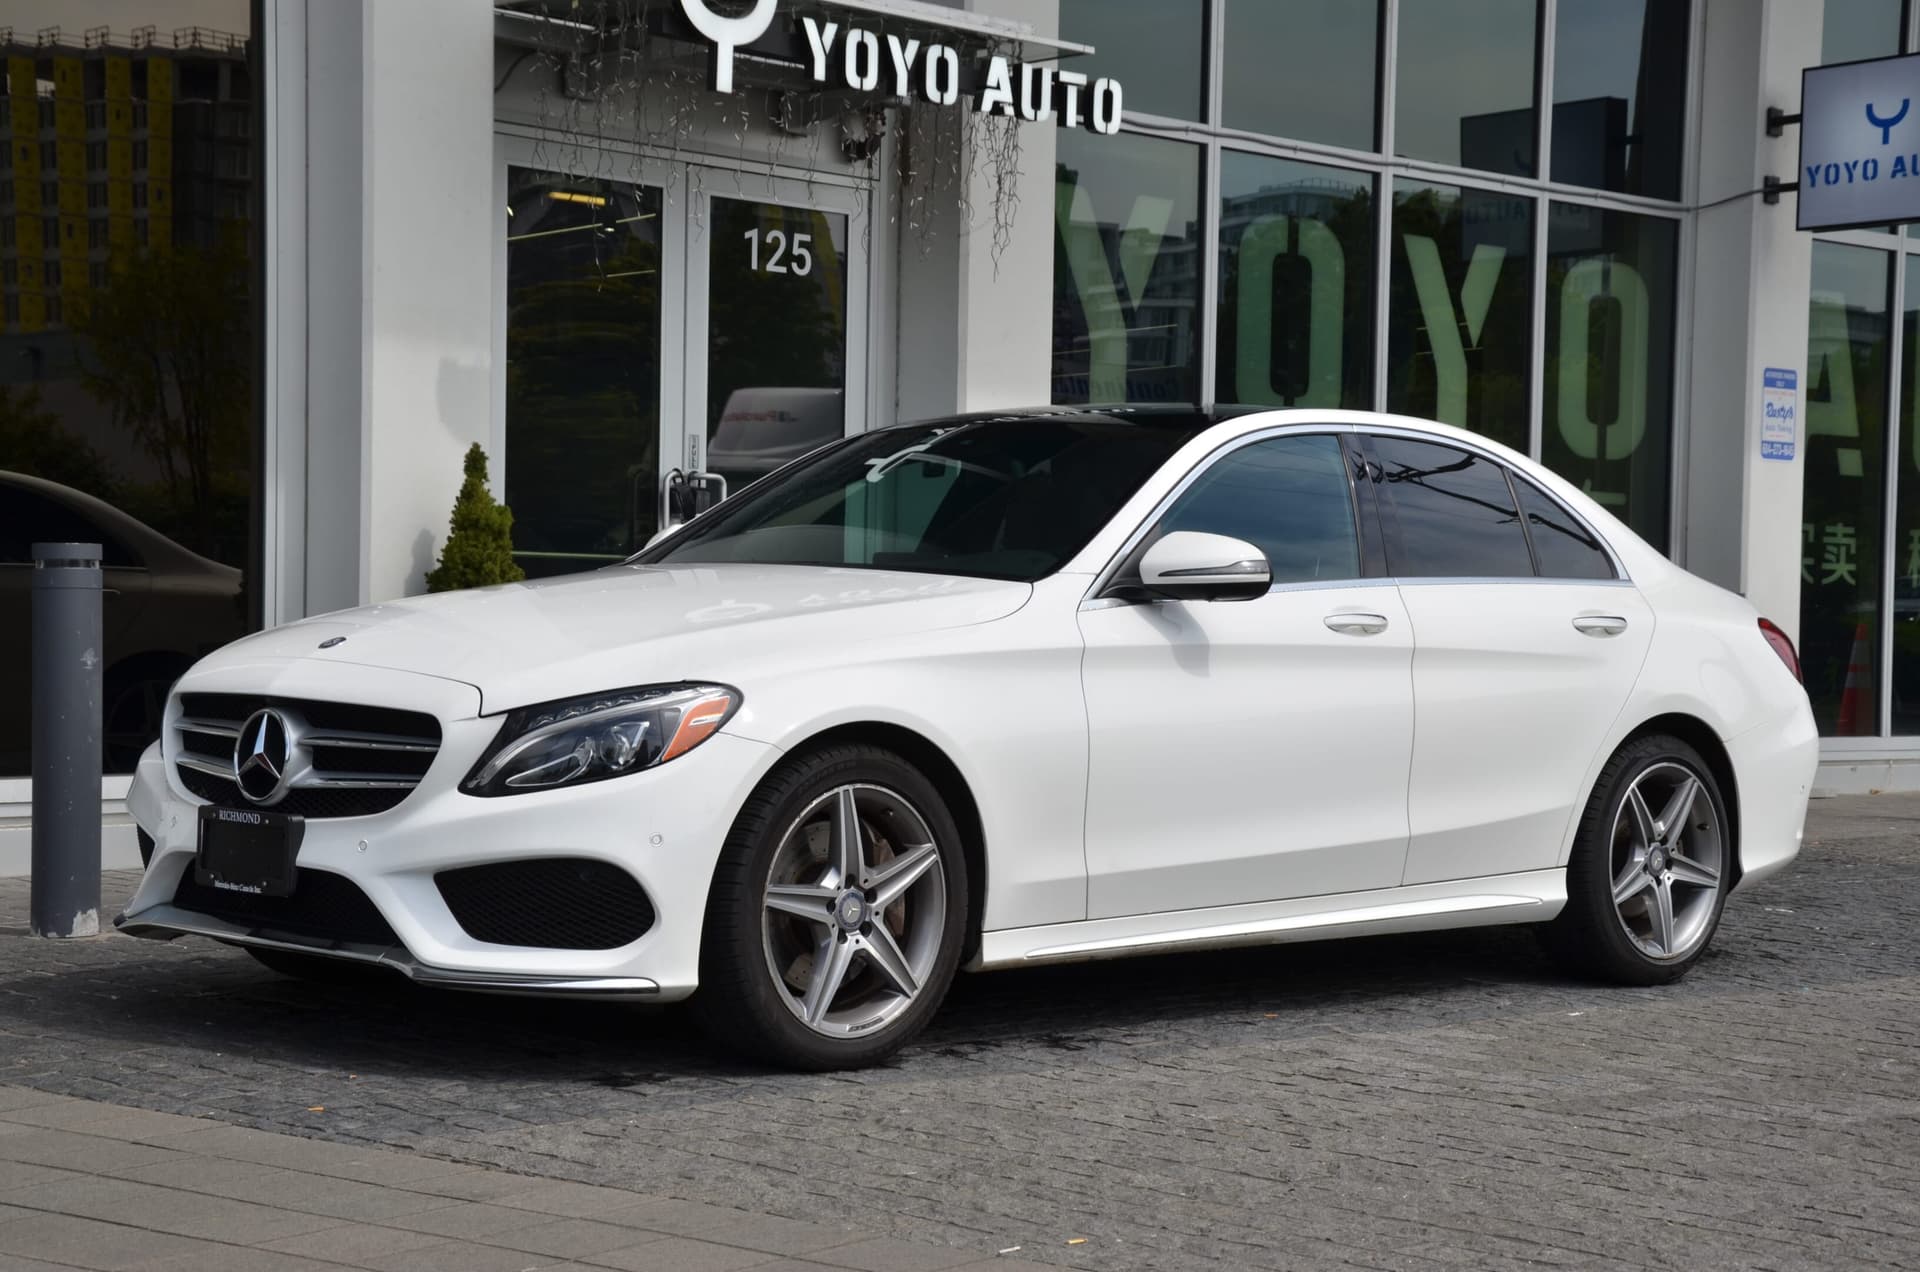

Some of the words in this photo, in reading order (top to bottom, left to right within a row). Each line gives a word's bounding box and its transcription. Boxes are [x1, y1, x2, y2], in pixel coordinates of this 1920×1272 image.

[802, 17, 958, 105] YOYO
[981, 56, 1123, 135] AUTO
[1806, 158, 1879, 188] YOYO
[744, 228, 812, 276] 125
[219, 809, 261, 825] RICHMOND
